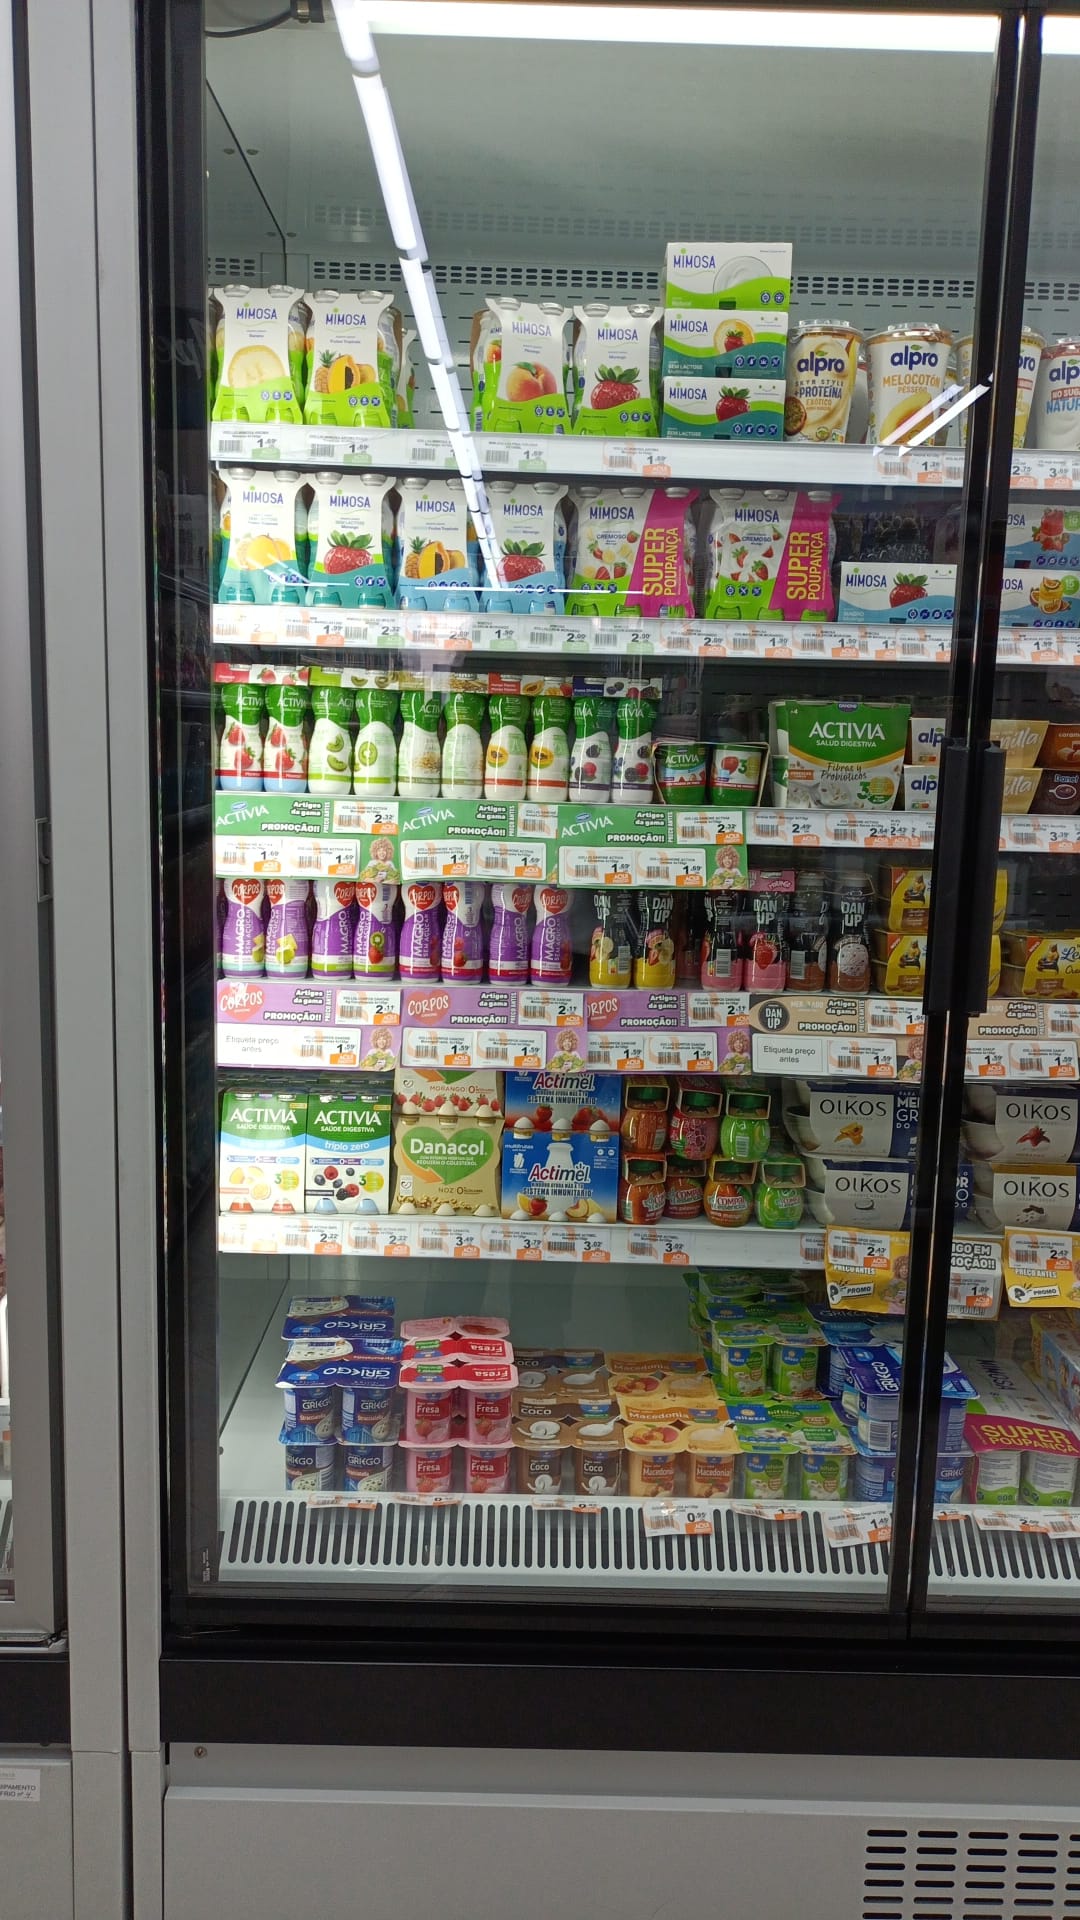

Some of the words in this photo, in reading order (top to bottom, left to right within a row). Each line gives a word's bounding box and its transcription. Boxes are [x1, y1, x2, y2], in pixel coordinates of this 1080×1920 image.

[673, 255, 716, 269] MIMOSA
[236, 308, 278, 320] MIMOSA
[325, 313, 367, 326] MIMOSA
[512, 322, 552, 337] MIMOSA
[670, 320, 709, 333] MIMOSA
[597, 328, 639, 341] MIMOSA
[890, 344, 939, 370] alpro
[796, 351, 845, 376] alpro
[882, 374, 941, 386] MELOCOTÓN
[669, 387, 708, 400] MIMOSA
[242, 491, 284, 504] MIMOSA
[329, 495, 371, 508] MIMOSA
[415, 500, 456, 513] MIMOSA
[503, 504, 544, 516] MIMOSA
[589, 507, 635, 520] MIMOSA
[734, 509, 780, 523] MIMOSA
[642, 527, 665, 597] SUPER
[663, 527, 680, 596] POUPANÇA
[787, 531, 811, 600] SUPER
[807, 531, 824, 600] POUPANÇA
[845, 574, 887, 588] MIMOSA
[809, 721, 887, 741] ACTIVIA
[665, 752, 700, 765] ACTIVIA
[827, 763, 853, 772] Fibras
[291, 808, 300, 816] da
[293, 802, 322, 810] Artigos
[479, 804, 507, 813] Artigos
[216, 804, 270, 828] ACTIVIA
[402, 808, 455, 833] ACTIVIA
[476, 812, 485, 820] da
[636, 811, 665, 820] Artigos
[261, 822, 321, 834] PROMOÇÃO!!
[447, 826, 507, 837] PROMOÇÃO!!
[561, 815, 614, 839] ACTIVIA
[606, 832, 665, 844] PROMOÇÃO!!
[233, 883, 260, 895] CORPOS
[594, 894, 611, 909] DAN
[652, 897, 673, 911] DAN
[753, 899, 778, 913] DAN
[597, 908, 610, 920] UP
[842, 902, 865, 915] DAN
[653, 911, 670, 923] UP
[756, 912, 776, 925] UP
[844, 914, 862, 927] UP
[234, 908, 246, 953] MAGRO
[338, 910, 349, 953] MAGRO
[414, 913, 425, 957] MAGRO
[514, 917, 524, 959] MAGRO
[545, 917, 557, 960] MAGRO
[295, 990, 324, 998] Artigos
[481, 992, 508, 1000] Artigos
[650, 995, 678, 1003] Artigos
[220, 990, 263, 1012] CORPOS
[293, 997, 302, 1005] da
[408, 995, 449, 1016] CORPOS
[479, 999, 487, 1007] da
[827, 1000, 857, 1009] Artigos
[1008, 1002, 1036, 1010] Artigos
[263, 1012, 322, 1022] PROMOÇÃO!!
[765, 1008, 783, 1018] DAN
[826, 1007, 834, 1015] da
[835, 1009, 856, 1017] gama
[451, 1015, 508, 1025] PROMOÇÃO!!
[620, 1018, 678, 1027] PROMOÇÃO!!
[767, 1018, 781, 1029] UP
[799, 1023, 856, 1033] PROMOÇÃO!!
[979, 1026, 1036, 1035] PROMOÇÃO!!
[258, 1037, 279, 1046] preço
[763, 1045, 798, 1055] Etiqueta
[800, 1047, 815, 1056] preço
[779, 1055, 800, 1063] antes
[533, 1073, 595, 1090] Actimel
[556, 1096, 595, 1105] INMUNITARIO
[819, 1098, 887, 1117] OIKOS
[1006, 1102, 1071, 1121] OIKOS
[230, 1108, 297, 1124] ACTIVIA
[314, 1110, 382, 1126] ACTIVIA
[320, 1125, 342, 1133] SAÚDE
[325, 1141, 348, 1151] triplo
[410, 1138, 485, 1156] Danacol
[529, 1165, 591, 1182] Actimel
[835, 1177, 902, 1194] OIKOS
[1003, 1180, 1070, 1198] OIKOS
[523, 1188, 549, 1196] SISTEMA
[551, 1189, 591, 1197] INMUNITARIO
[973, 1244, 992, 1256] EM
[847, 1286, 872, 1294] PROMO
[1033, 1288, 1057, 1296] PROMO
[470, 1344, 504, 1353] Fresa
[475, 1369, 509, 1378] Fresa
[417, 1404, 440, 1414] Fresa
[476, 1404, 500, 1413] Fresa
[981, 1424, 1071, 1445] SUPER
[989, 1436, 1080, 1453] POUPANÇA
[417, 1462, 441, 1472] Fresa
[471, 1462, 495, 1472] Fresa
[530, 1462, 550, 1471] Coco
[583, 1462, 604, 1472] Coco
[697, 1468, 731, 1477] Macedonia
